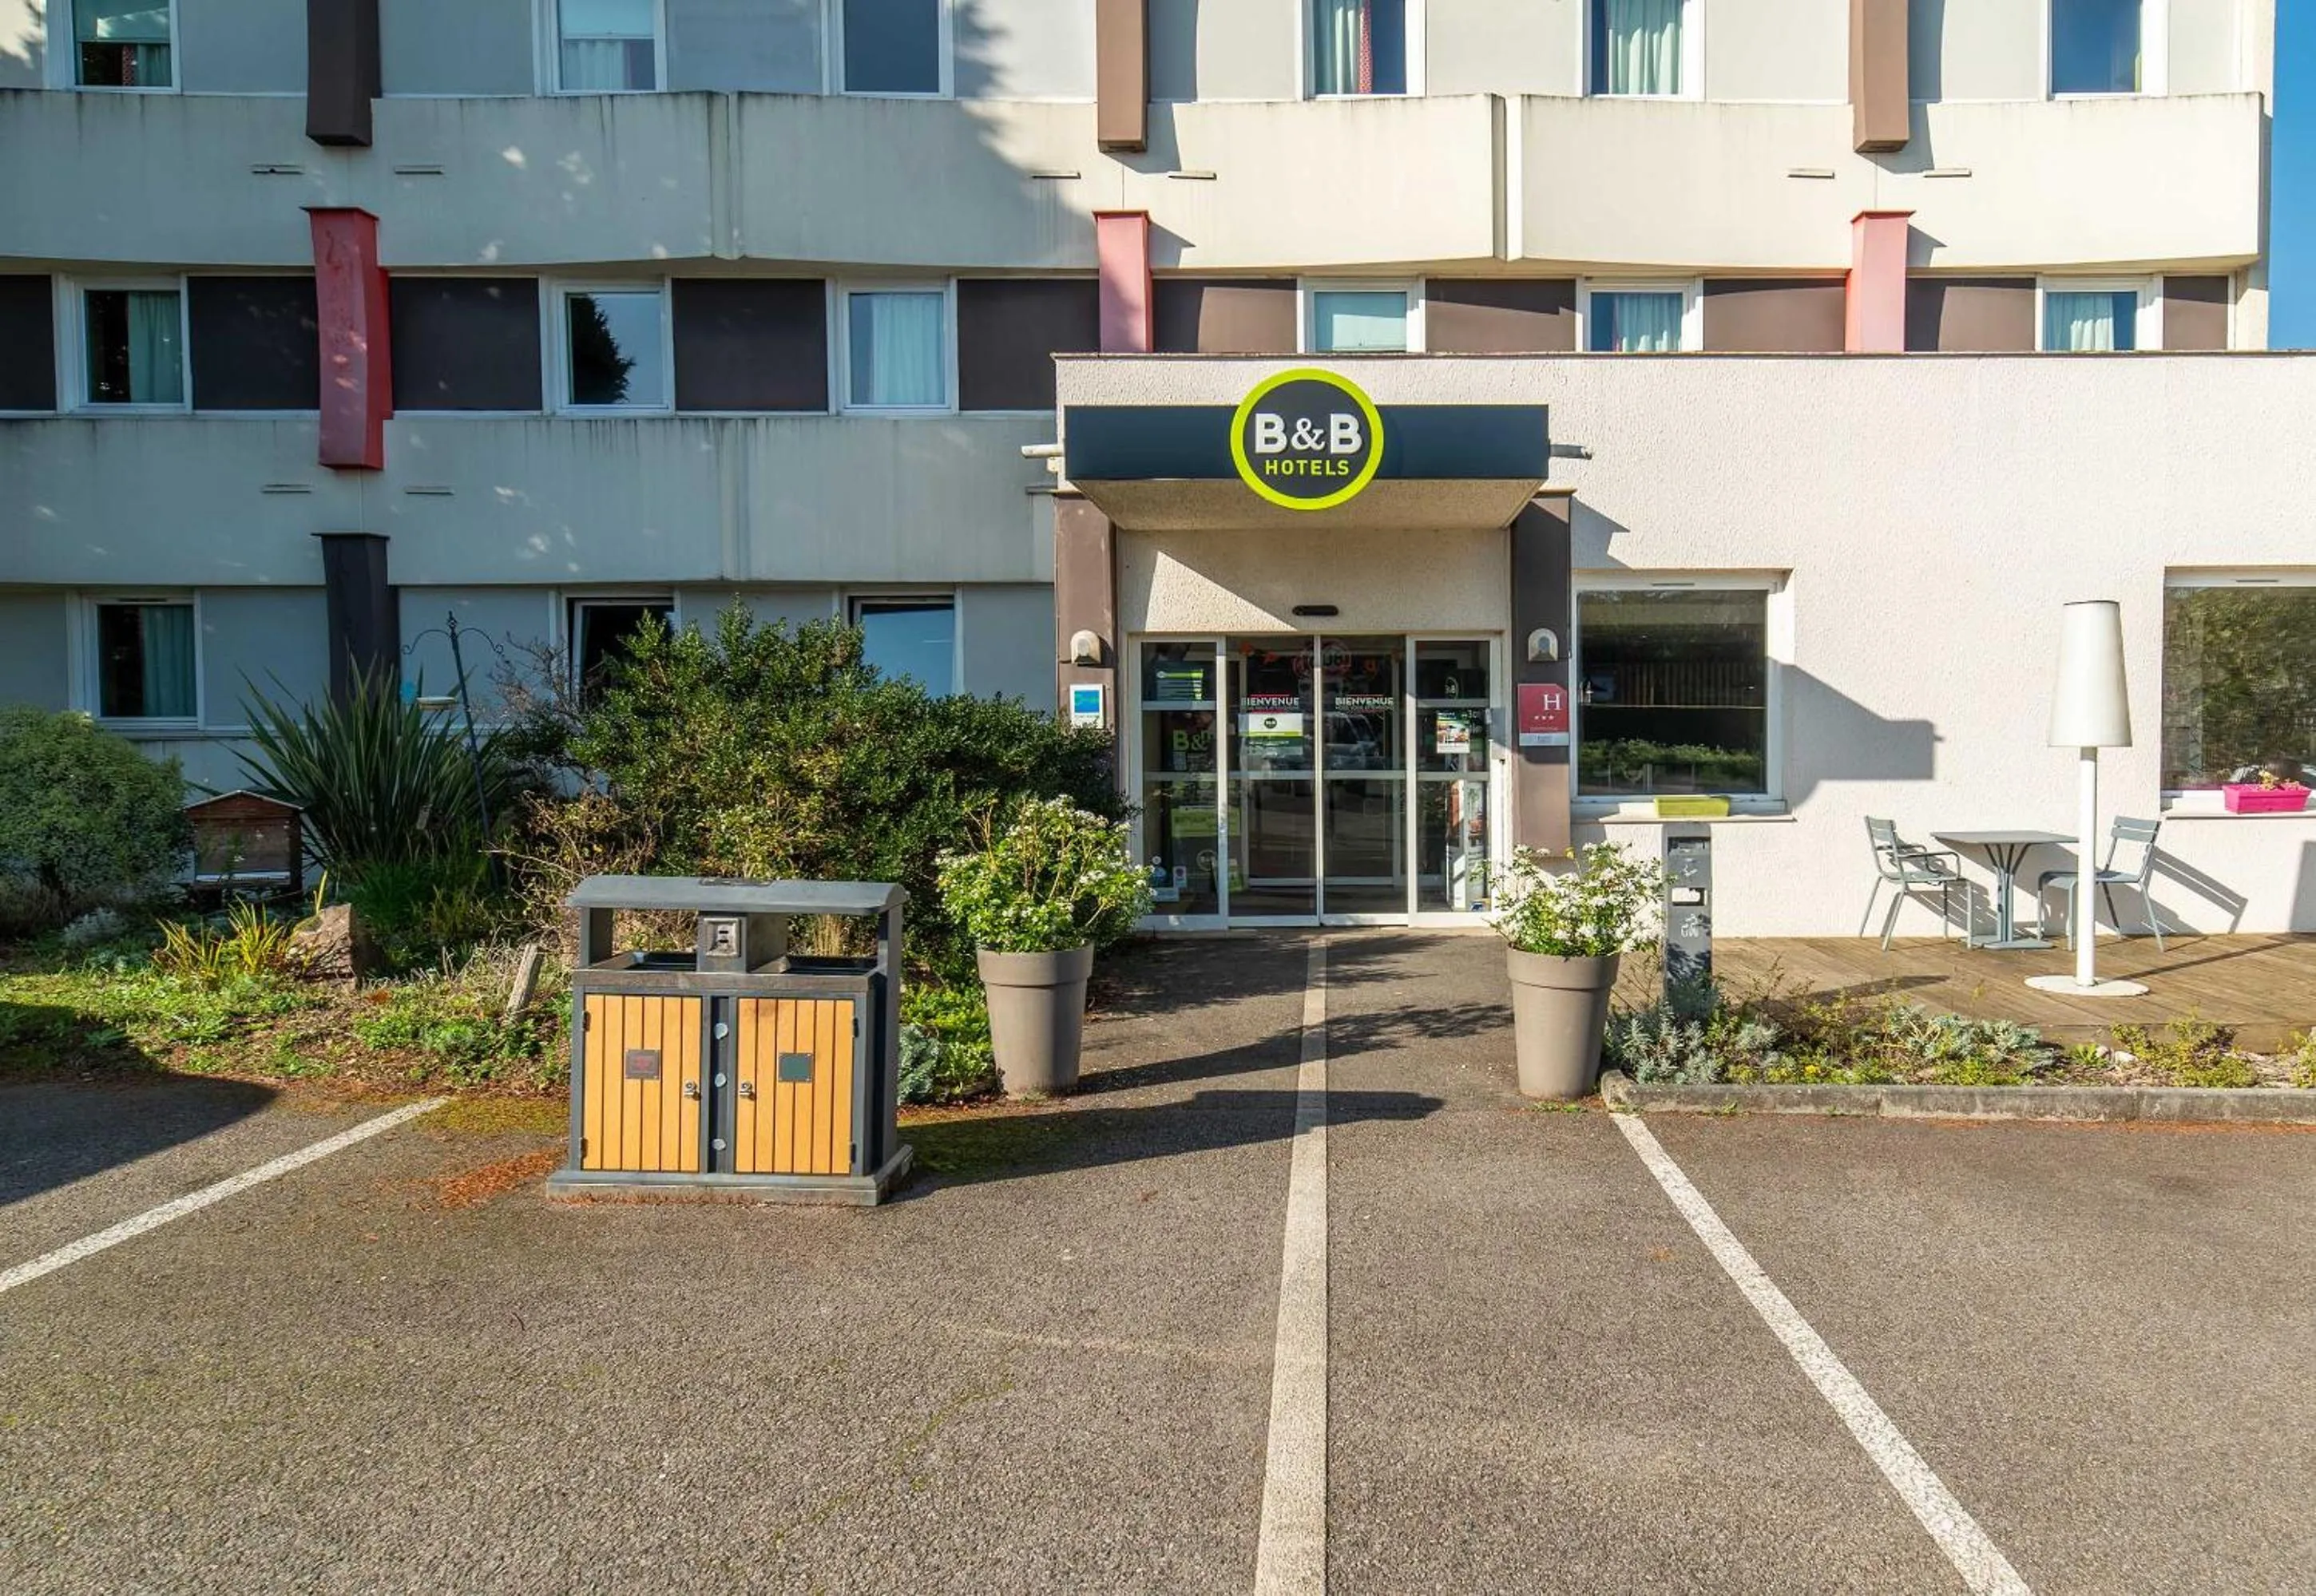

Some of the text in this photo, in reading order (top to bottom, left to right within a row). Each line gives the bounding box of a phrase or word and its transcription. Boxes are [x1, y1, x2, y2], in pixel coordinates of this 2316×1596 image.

[1254, 413, 1363, 454] B&B
[1265, 460, 1350, 476] HOTELS
[1240, 697, 1300, 707] BIENVENUE
[1334, 697, 1394, 706] BIENVENUE
[1543, 693, 1562, 711] H
